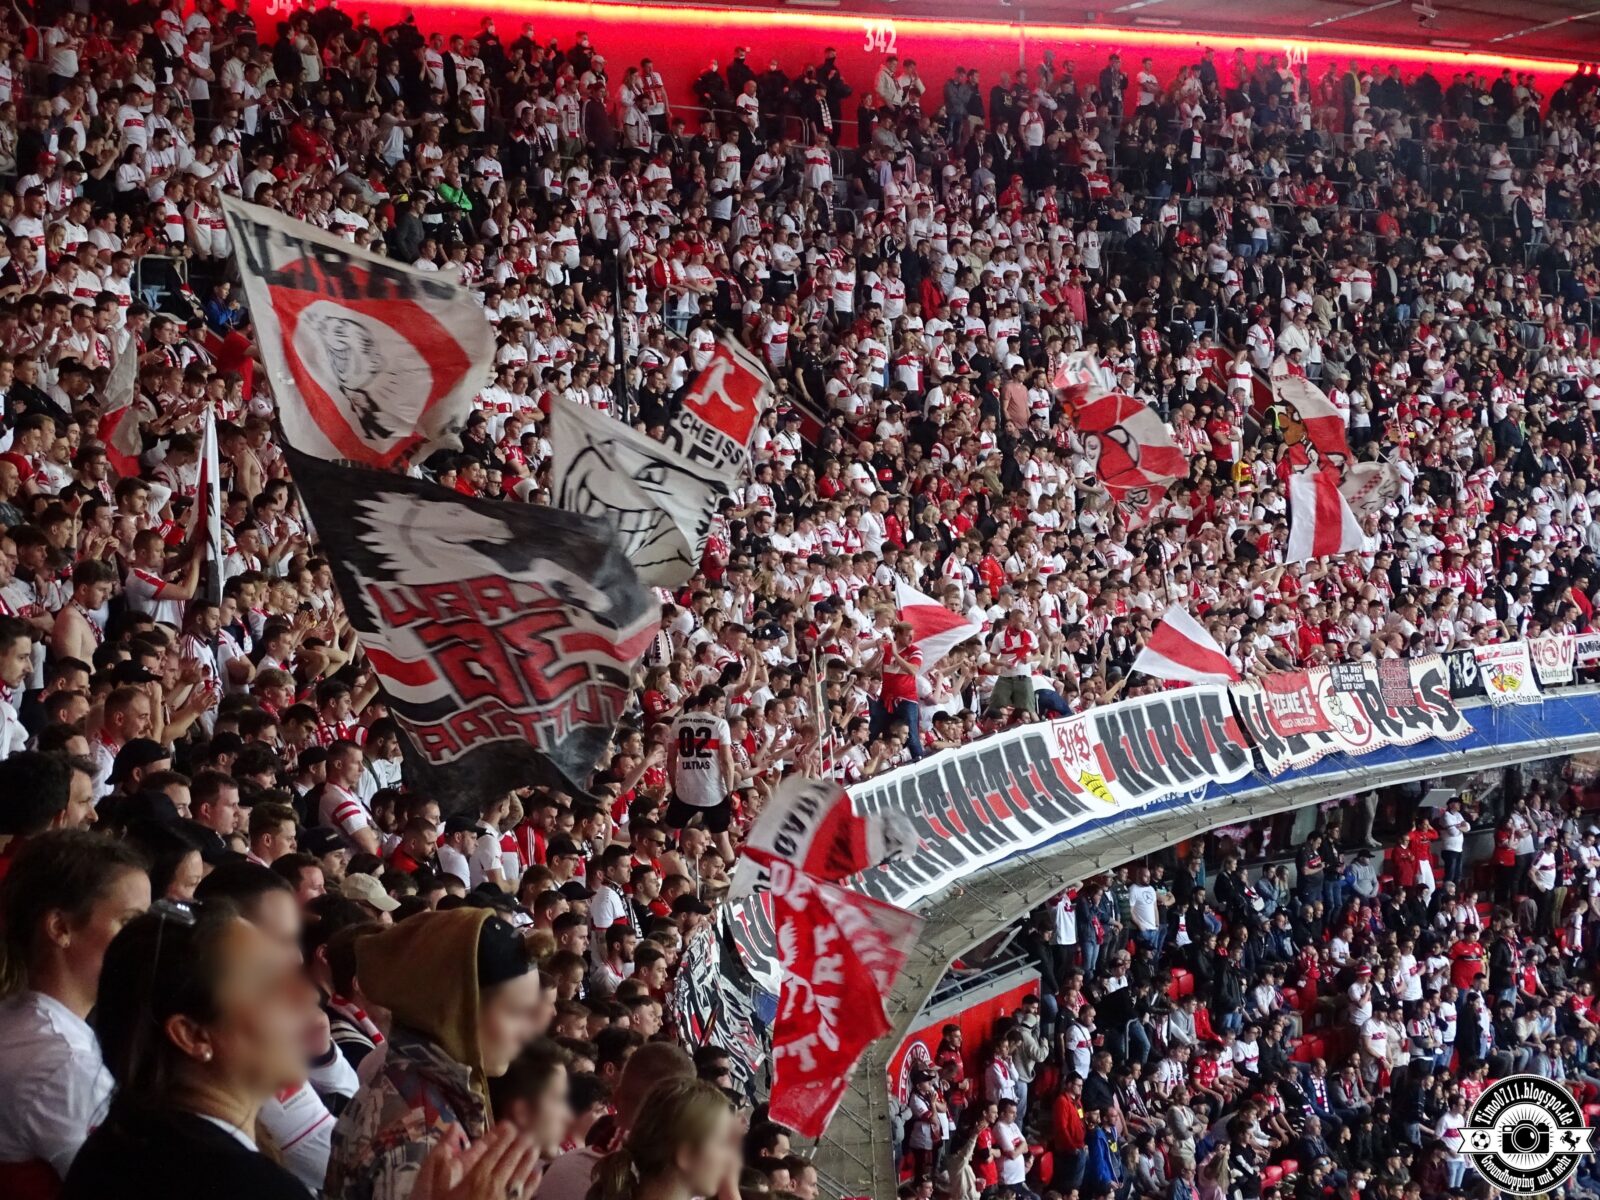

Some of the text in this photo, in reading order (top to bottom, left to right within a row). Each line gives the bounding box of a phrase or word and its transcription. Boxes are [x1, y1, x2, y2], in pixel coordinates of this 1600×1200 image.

[864, 21, 897, 54] 342
[679, 726, 713, 758] 02
[1096, 691, 1252, 798] KURVE
[682, 760, 710, 770] ULTRAS
